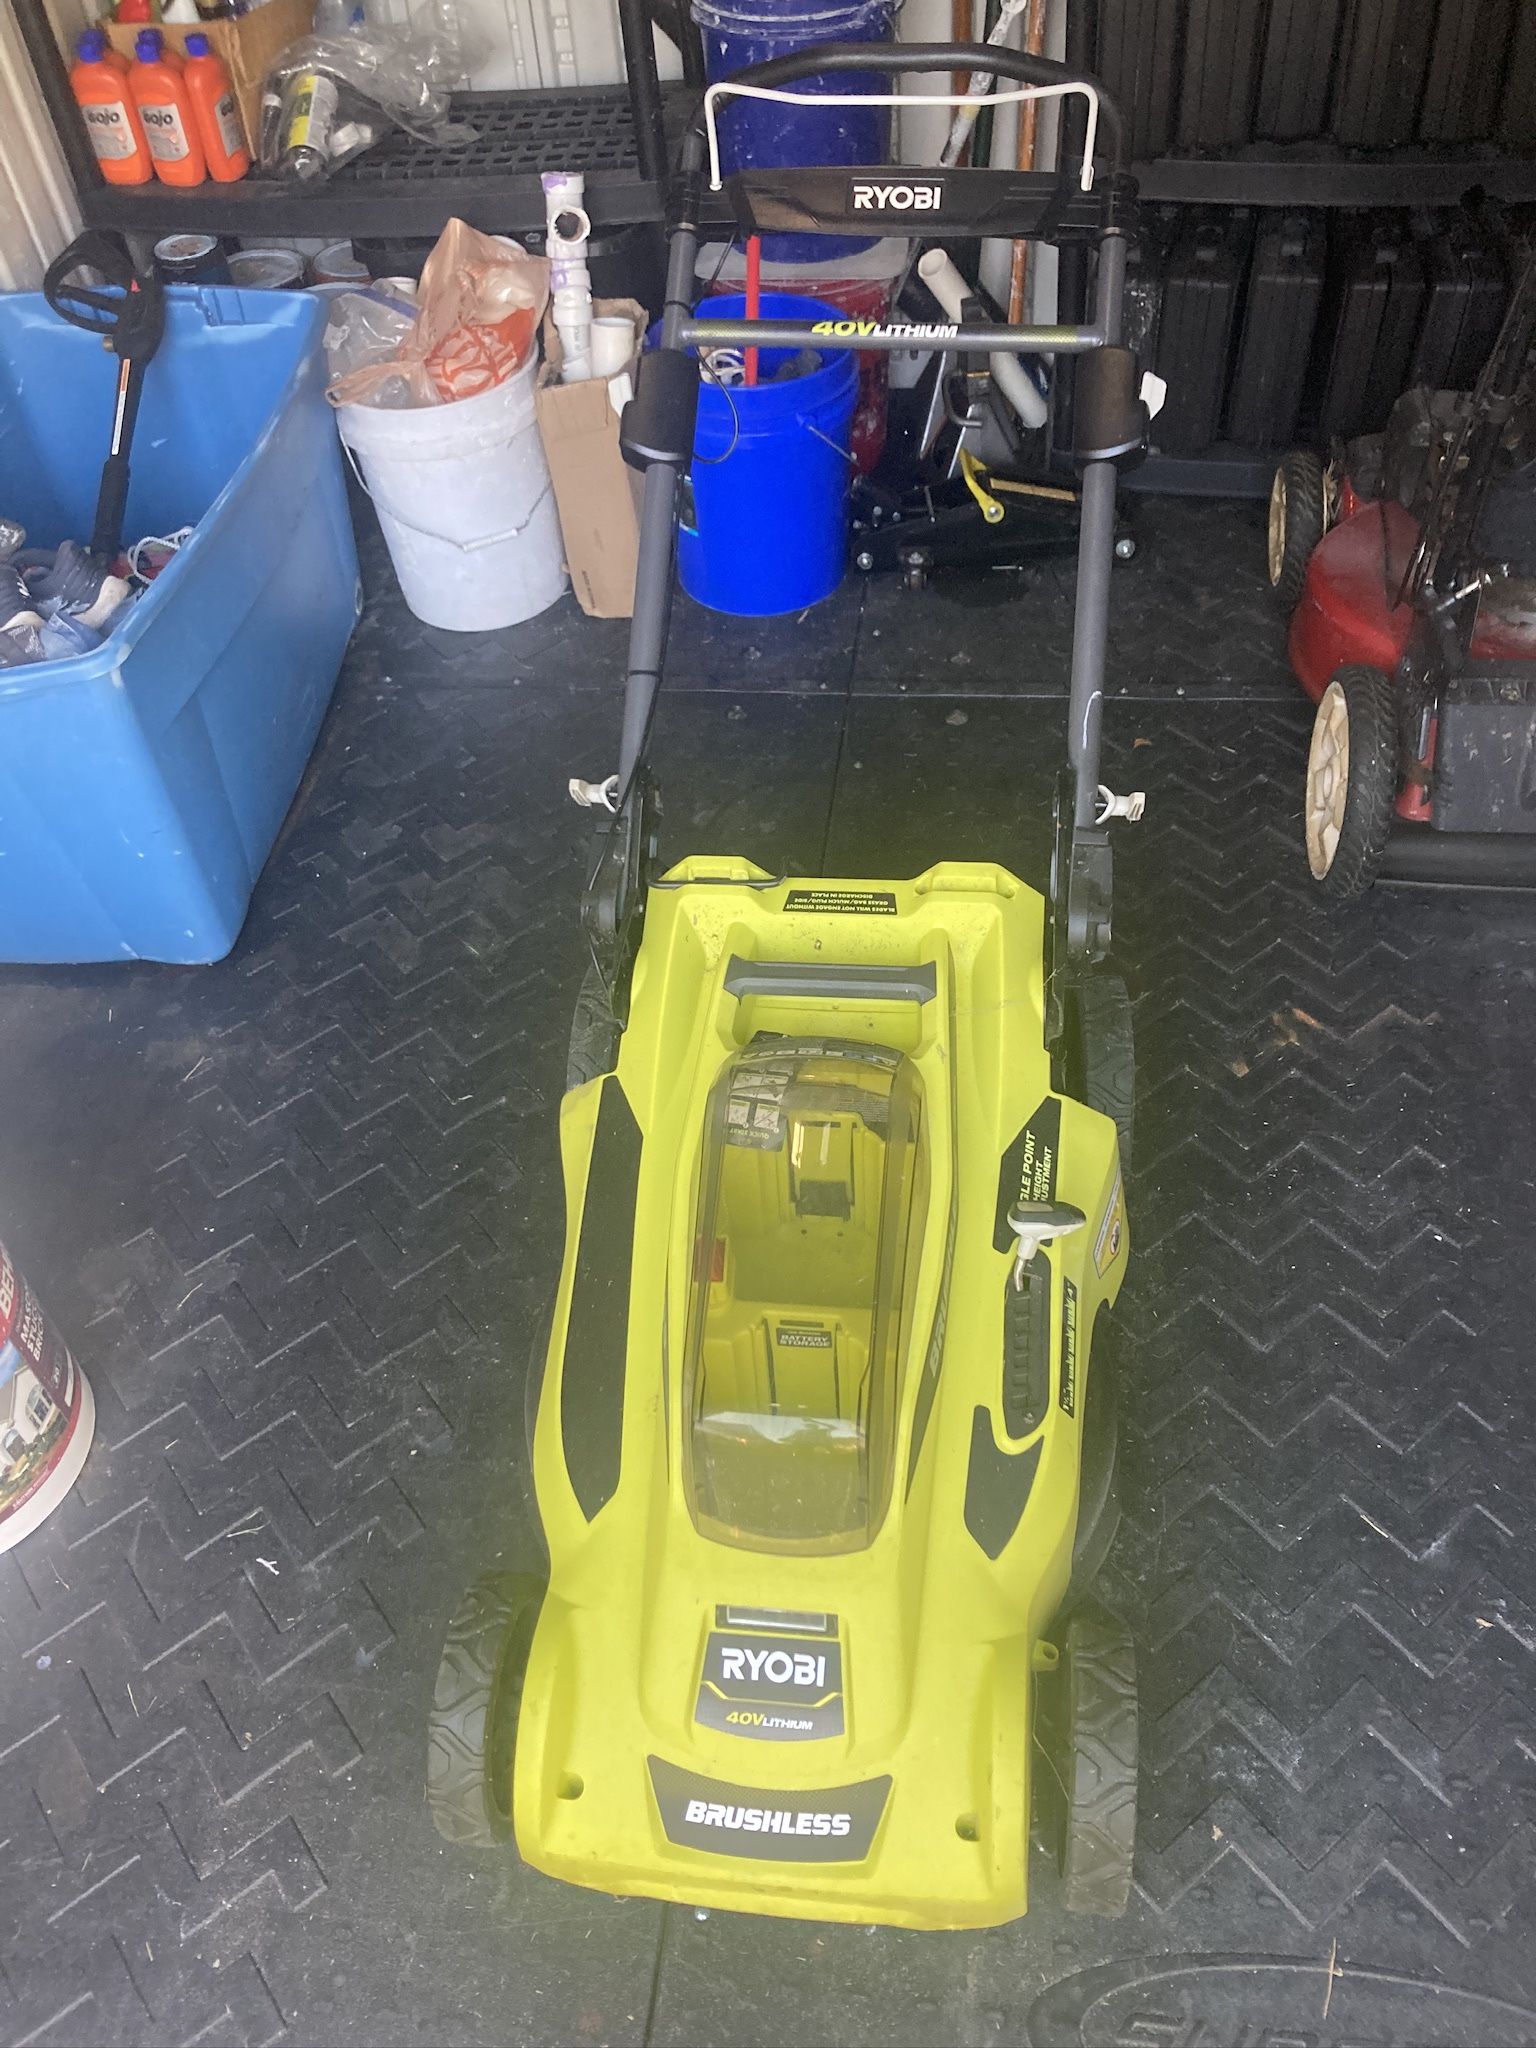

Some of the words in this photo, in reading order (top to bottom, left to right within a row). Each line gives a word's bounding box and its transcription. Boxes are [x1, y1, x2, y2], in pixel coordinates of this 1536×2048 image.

[853, 186, 941, 210] RYOBI
[1023, 1130, 1036, 1175] POINT
[1020, 1175, 1031, 1201] GLE
[1041, 1146, 1053, 1201] USTMENT
[780, 1334, 828, 1342] BATTERY
[721, 1647, 826, 1687] RYOBI
[684, 1800, 852, 1836] BRUSHLESS
